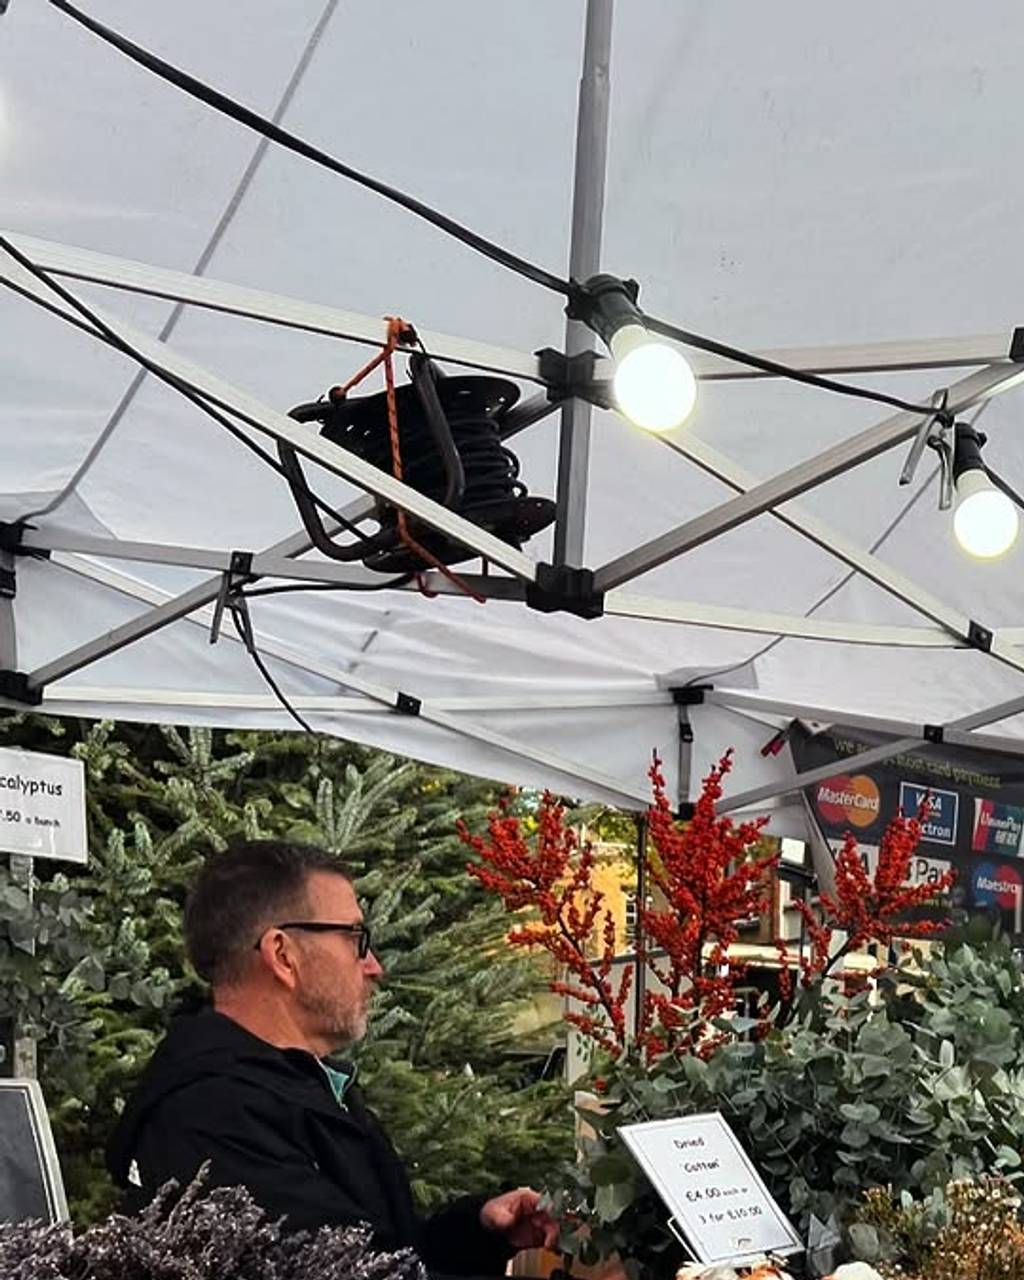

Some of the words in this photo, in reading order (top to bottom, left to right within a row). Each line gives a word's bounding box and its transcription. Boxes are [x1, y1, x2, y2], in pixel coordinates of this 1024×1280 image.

[817, 786, 880, 811] MasterCard
[915, 792, 941, 810] VSA
[916, 858, 943, 884] Pa
[976, 876, 1017, 894] Maestro
